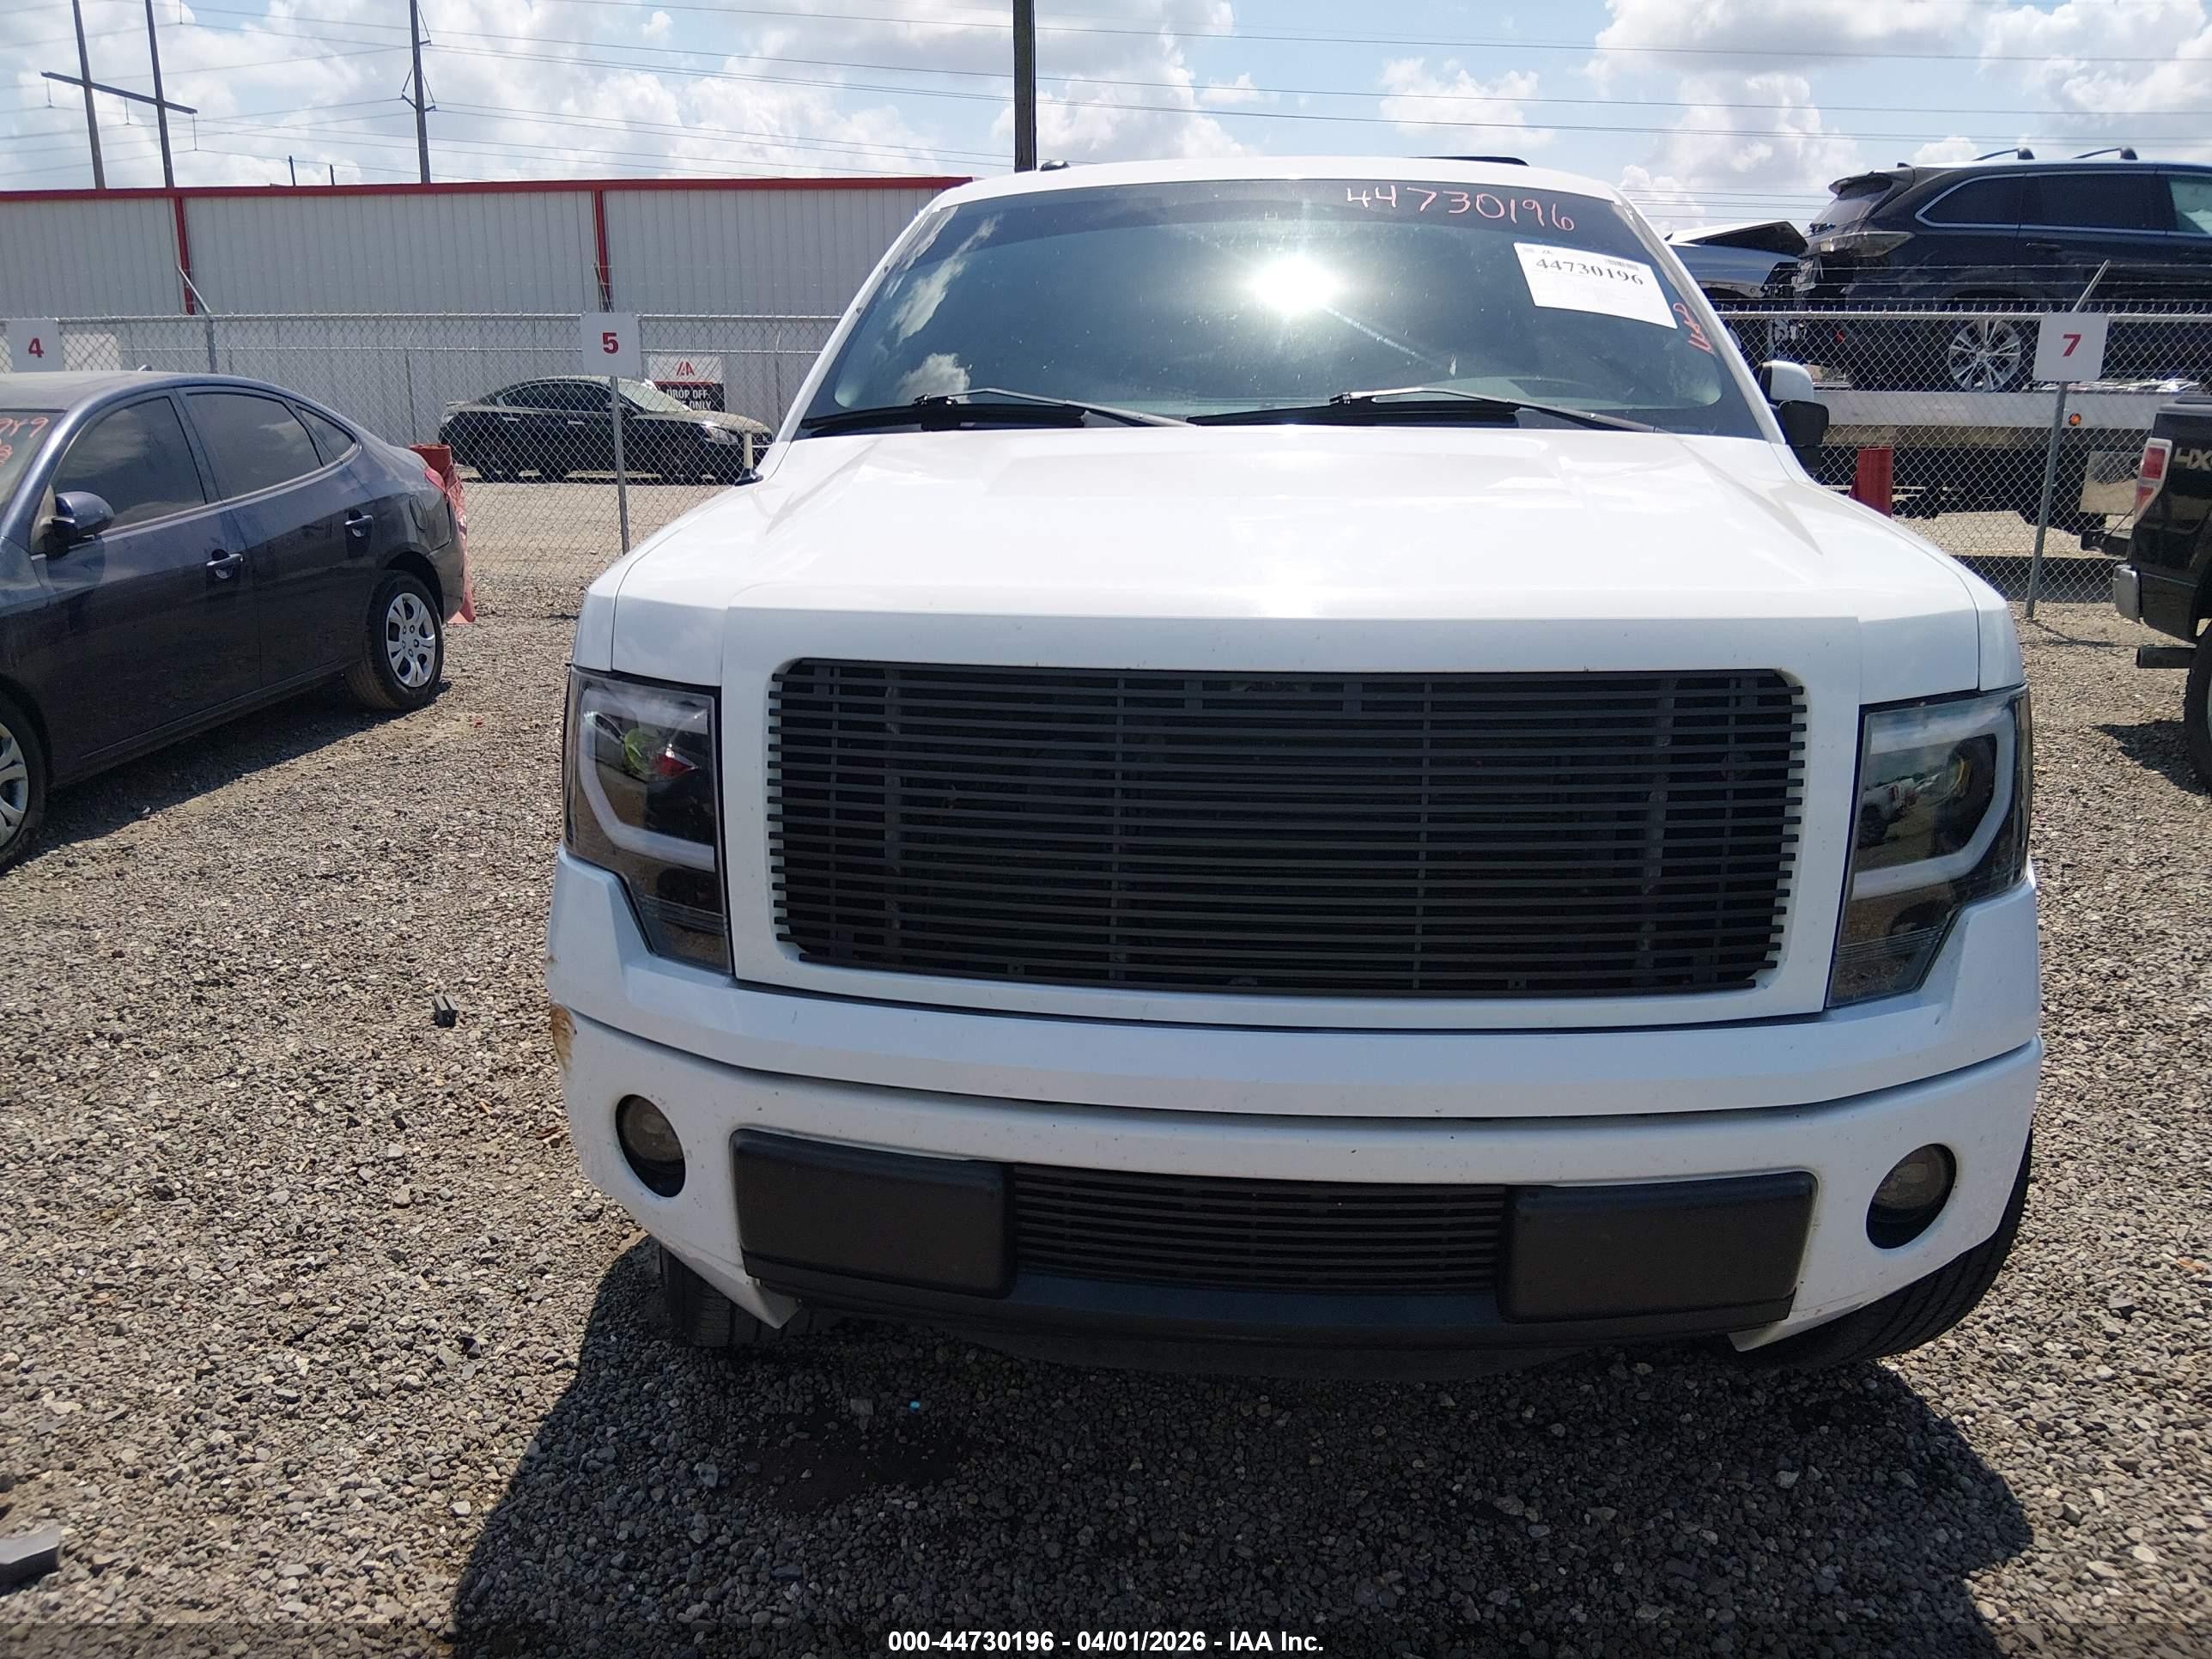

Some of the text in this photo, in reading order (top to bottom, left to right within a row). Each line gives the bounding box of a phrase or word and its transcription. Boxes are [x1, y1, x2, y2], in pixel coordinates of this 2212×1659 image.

[1346, 185, 1575, 231] 44730196
[1535, 258, 1644, 286] 44730196
[27, 337, 45, 358] 4
[602, 331, 619, 355] 5
[2062, 333, 2081, 357] 7
[692, 389, 708, 399] OFF
[2173, 447, 2212, 471] 4X
